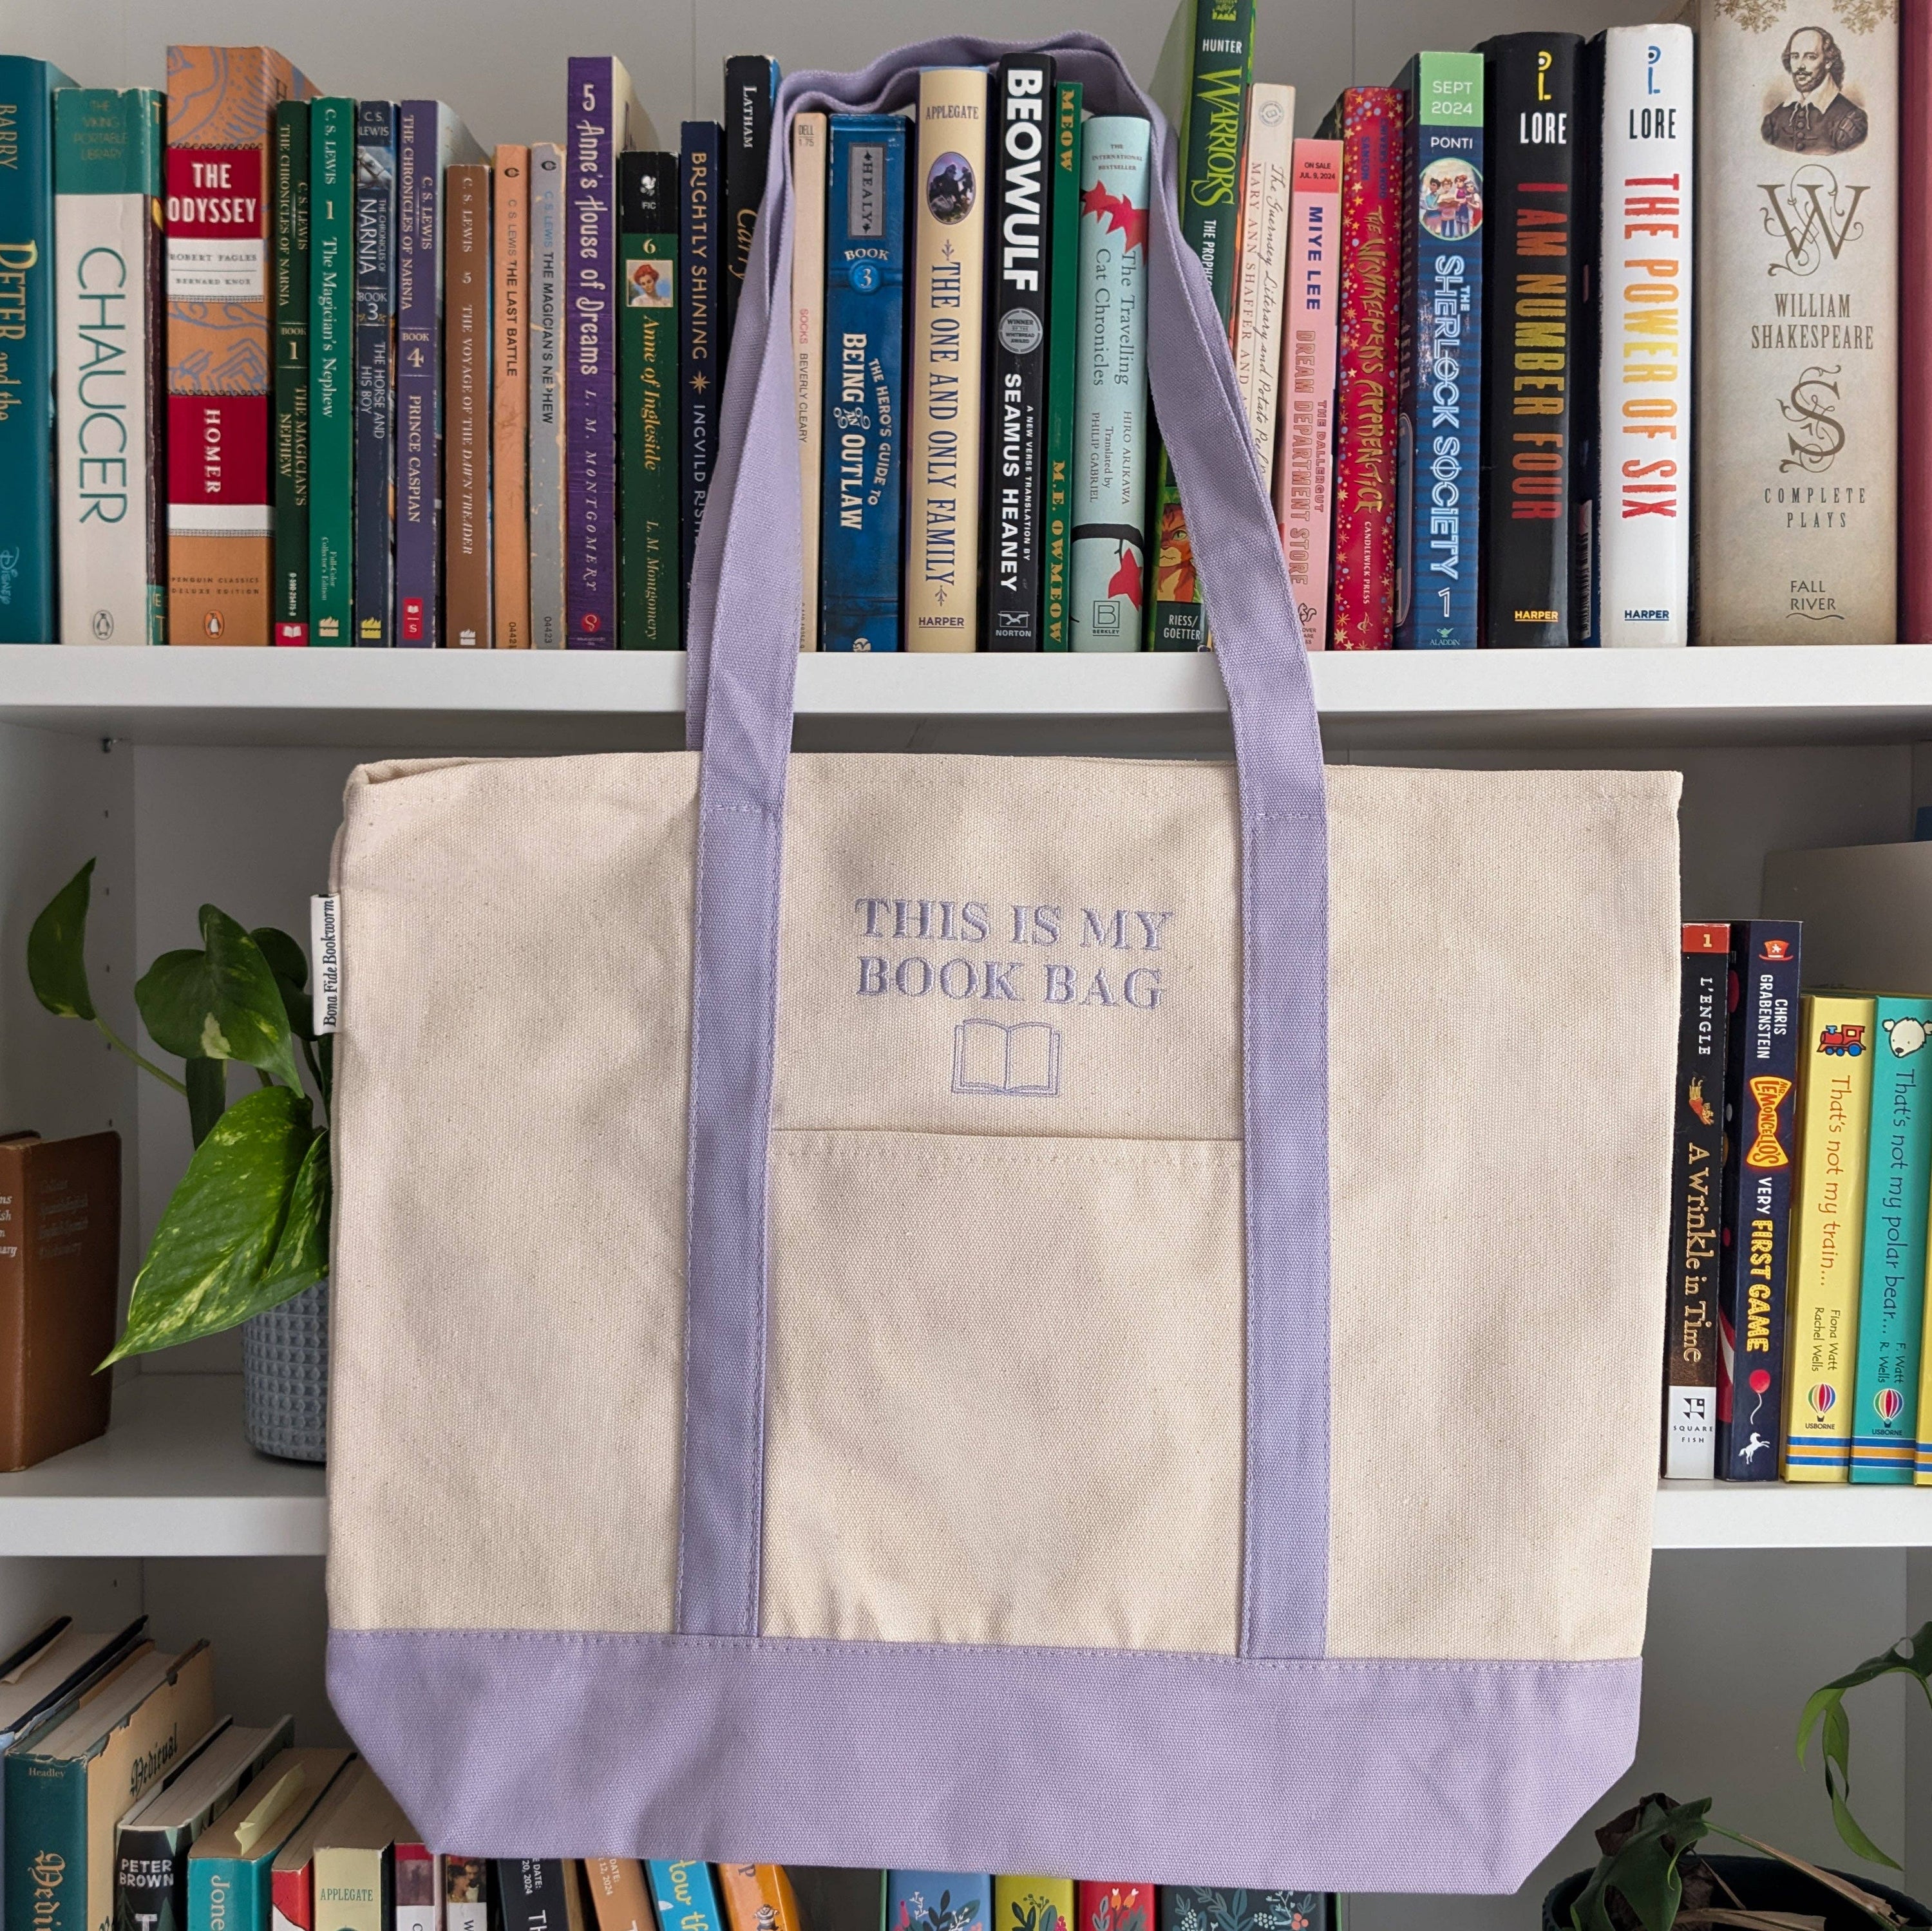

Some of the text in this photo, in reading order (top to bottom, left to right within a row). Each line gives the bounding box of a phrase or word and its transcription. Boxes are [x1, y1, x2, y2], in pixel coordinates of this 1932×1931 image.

[1202, 39, 1242, 54] HUNTER
[743, 86, 757, 149] LATHAM
[926, 106, 979, 119] APPLEGATE
[1432, 81, 1473, 95] SEPT
[1432, 102, 1473, 115] 2024
[1059, 89, 1074, 172] MEOW
[1191, 66, 1242, 207] WARRIORS
[1430, 137, 1473, 149] PONTI
[1520, 112, 1567, 144] LORE
[1629, 108, 1676, 139] LORE
[191, 163, 232, 189] THE
[862, 162, 873, 225] HEALY
[1003, 69, 1043, 292] BEOWULF
[167, 197, 256, 223] ODYSSEY
[360, 199, 377, 275] NARNIA
[1247, 162, 1262, 254] MARY ANN
[643, 240, 656, 254] 6
[844, 249, 889, 261] BOOK
[1307, 206, 1323, 310] MIYE LEE
[317, 238, 338, 418] The Magician's Nephew
[506, 260, 518, 377] THE LAST BATTLE
[690, 153, 707, 483] BRIGHTLY SHINING INGVILD
[1094, 249, 1112, 386] Cat Chronicles
[1114, 250, 1135, 385] The Travelling
[1253, 195, 1283, 422] Guernsey Literary Potato
[1460, 285, 1470, 312] THE
[1775, 293, 1850, 318] WILLIAM
[402, 333, 429, 341] BOOK
[408, 348, 424, 368] 4
[575, 84, 608, 592] 5 Anne's House of Dreams MONTGOMERY
[1511, 183, 1567, 519] I AM NUMBER FOUR
[1622, 173, 1679, 518] THE POWER OF SIX
[1752, 325, 1873, 350] SHAKESPEARE
[78, 247, 127, 523] CHAUCER
[641, 315, 661, 471] Anne of Ingleside
[799, 353, 808, 400] BEVERLY
[840, 332, 867, 531] BEING OUTLAW
[867, 358, 892, 505] THE HERO'S GUIDE TO
[925, 262, 961, 586] THE ONE AND ONLY FAMILY
[1354, 379, 1386, 514] APPRENTICE
[1430, 256, 1464, 579] SHERLOCK SOCIETY
[204, 408, 222, 494] HOMER
[408, 395, 421, 523] PRINCE CASPIAN
[1090, 411, 1099, 503] PHILIP GABRIEL
[1122, 411, 1132, 505] HIRO ARIKAWA
[1289, 330, 1316, 585] DREAM DEPARTMENT STORE
[1314, 400, 1327, 513] THE DALLERGUT
[1001, 373, 1021, 592] SEAMUS HEANEY
[1024, 476, 1032, 545] TRANSLATION
[1765, 488, 1866, 503] COMPLETE
[1787, 513, 1846, 528] PLAYS
[1050, 520, 1064, 643] OWMEOW
[1790, 580, 1826, 593] FALL
[1790, 598, 1835, 610] RIVER
[544, 616, 553, 644] 04423
[919, 617, 964, 626] HARPER
[996, 629, 1032, 637] NORTON
[1163, 627, 1201, 640] GOETTER
[1169, 614, 1197, 626] RIESS/
[1515, 610, 1558, 620] HARPER
[1625, 610, 1669, 619] HARPER
[855, 898, 1174, 950] THIS IS MY
[321, 900, 337, 1027] Bona Fide Bookworm
[856, 956, 1164, 1009] BOOK BAG
[1698, 977, 1712, 1056] L'ENGLE
[1757, 974, 1774, 1059] GRABENSTEIN
[1774, 999, 1788, 1036] CHRIS
[1829, 1075, 1852, 1133] That's
[1826, 1140, 1844, 1175] not
[1756, 1176, 1772, 1215] VERY
[1819, 1182, 1839, 1214] my
[1683, 1142, 1716, 1363] A Wrinkle in Time
[1750, 1220, 1773, 1281] FIRST
[1882, 1216, 1908, 1269] polar
[1746, 1283, 1771, 1352] GAME
[1812, 1307, 1824, 1372] Rachel Wells
[1827, 1309, 1841, 1371] Fiona Watt
[119, 1872, 174, 1887] BROWN
[321, 1889, 374, 1902] APPLEGATE
